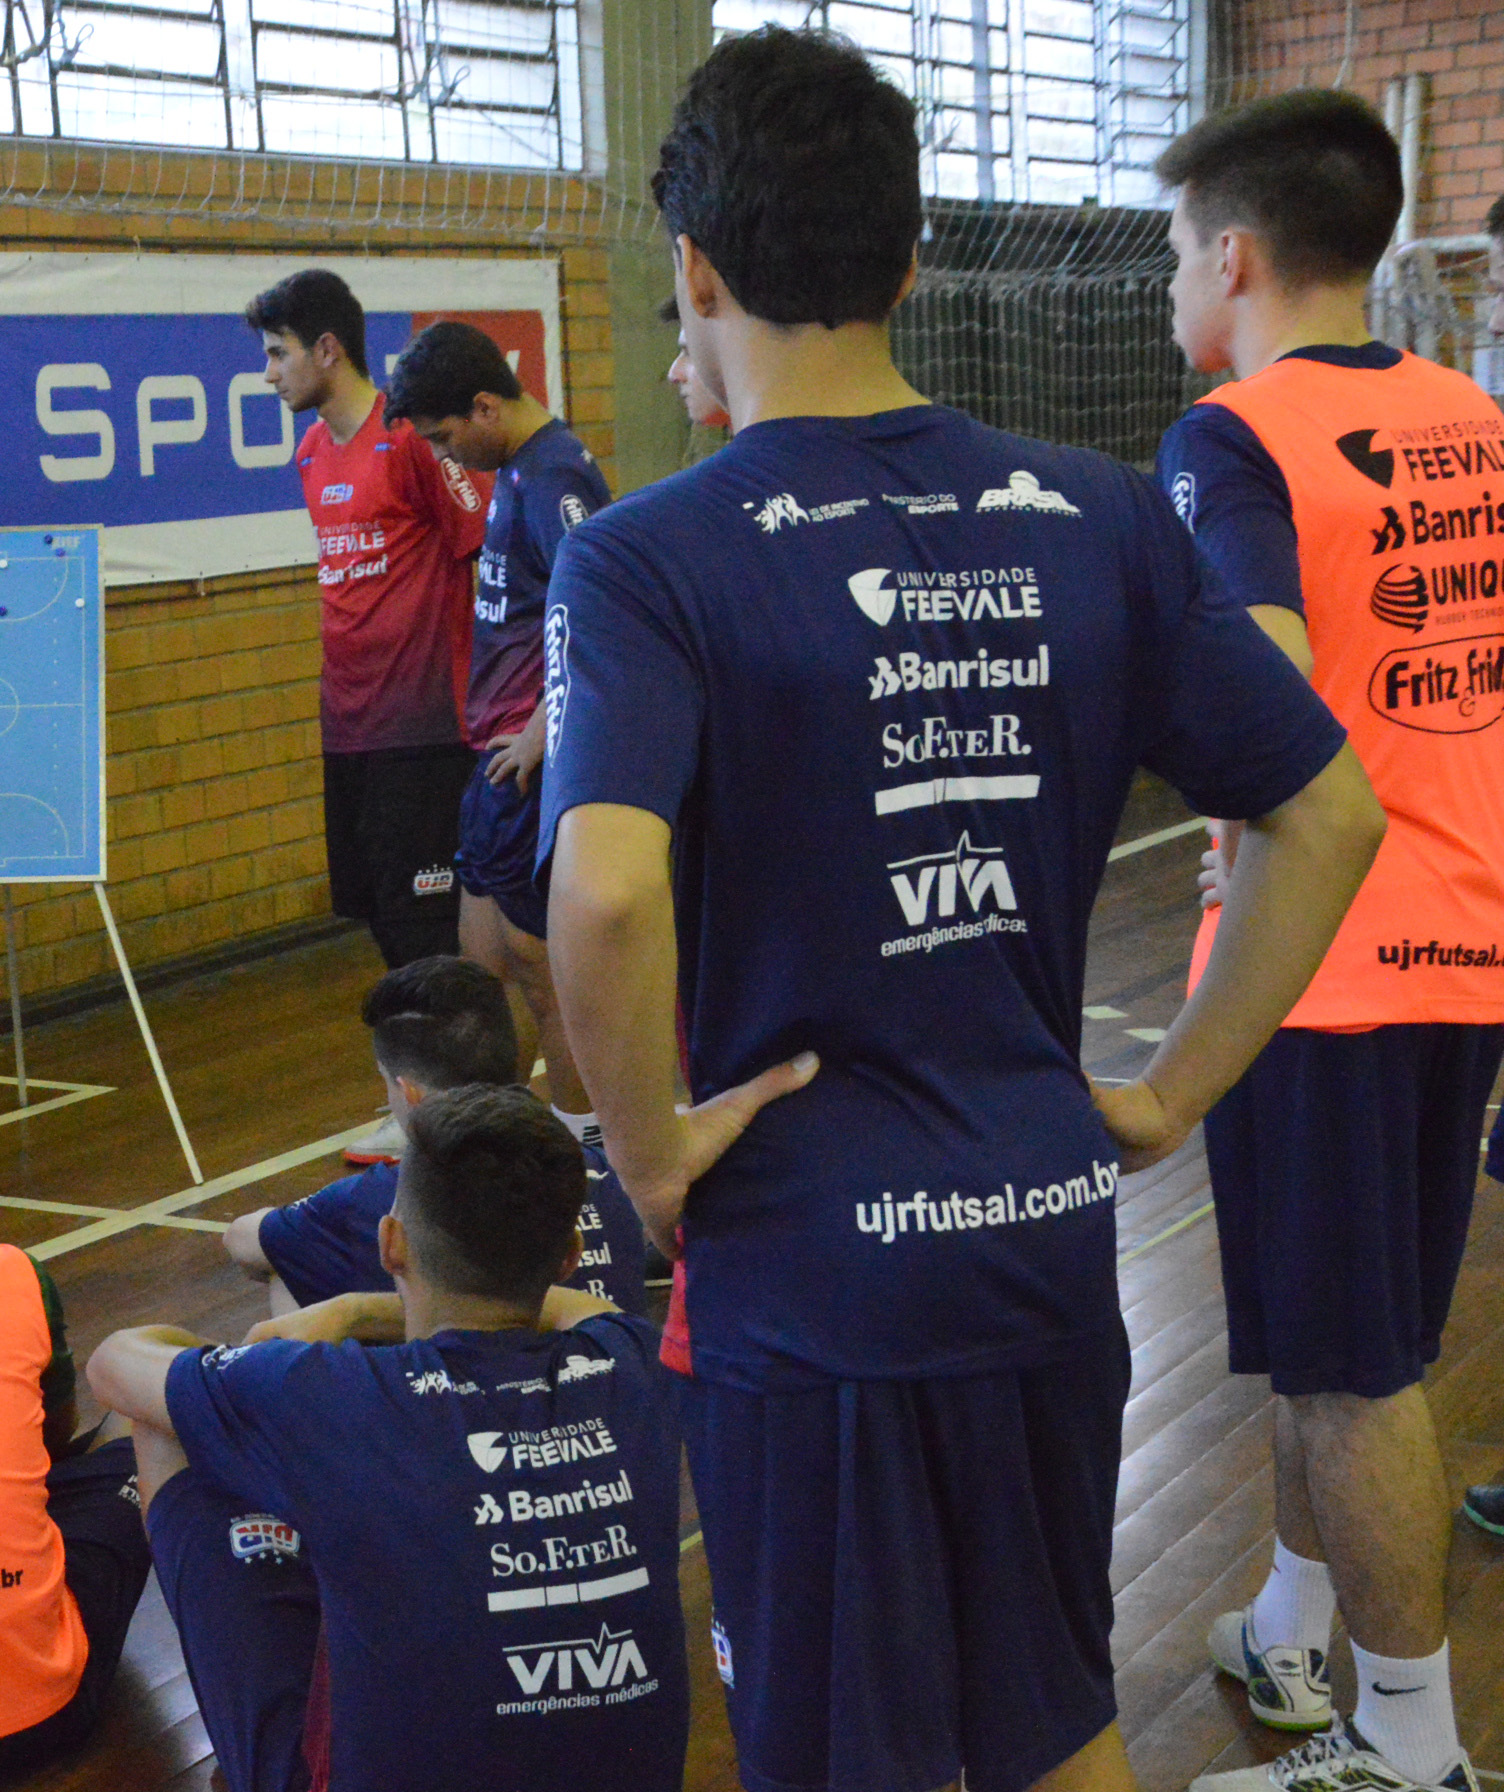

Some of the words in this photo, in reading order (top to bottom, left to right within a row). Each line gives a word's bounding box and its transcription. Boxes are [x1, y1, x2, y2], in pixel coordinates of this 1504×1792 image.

[1402, 438, 1504, 482] FEEVAL
[901, 586, 1044, 622] FEEVALE
[1432, 559, 1504, 606] UNIQ
[899, 644, 1049, 692] Banrisul
[856, 1159, 1120, 1244] ujrfutsal.com.br
[512, 1430, 618, 1470] FEEVALE
[509, 1469, 634, 1522] Banrisul
[507, 1638, 649, 1695] VIVA
[496, 1692, 600, 1716] emergências
[605, 1678, 659, 1706] médicas
